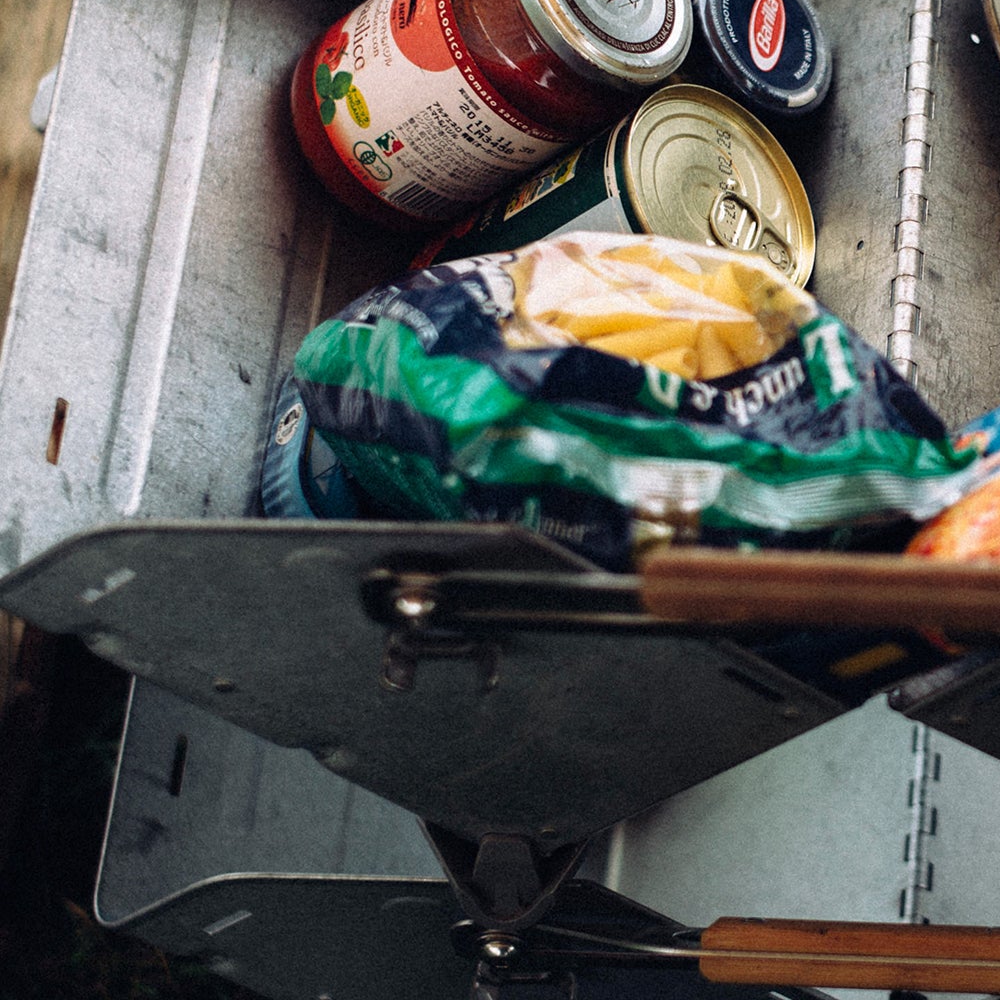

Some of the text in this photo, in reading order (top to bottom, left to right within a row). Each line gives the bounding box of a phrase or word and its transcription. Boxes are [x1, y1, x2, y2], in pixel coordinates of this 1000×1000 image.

[397, 2, 408, 31] nero
[802, 29, 812, 52] ITALY
[794, 61, 811, 80] MADE
[462, 65, 496, 107] Tomato
[723, 322, 855, 427] Lunch
